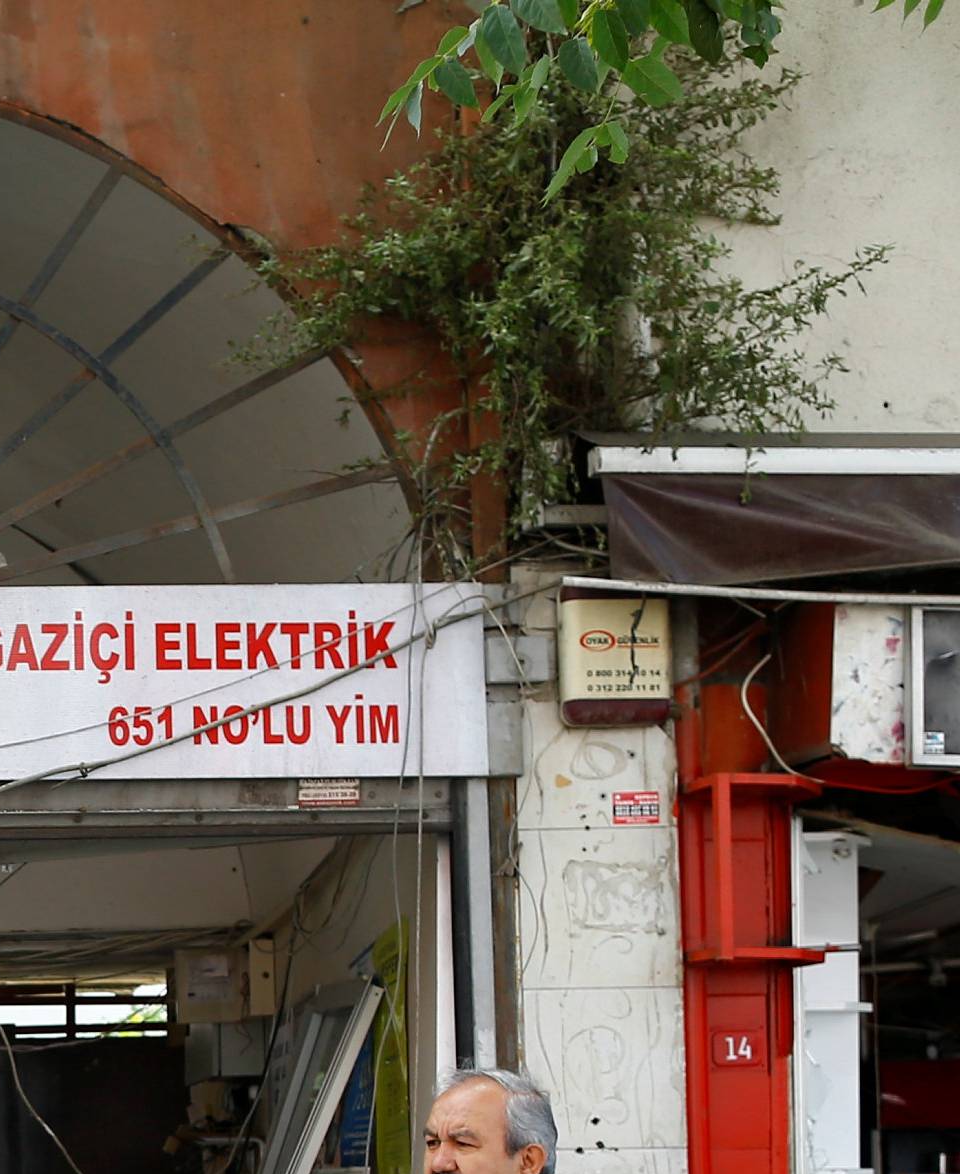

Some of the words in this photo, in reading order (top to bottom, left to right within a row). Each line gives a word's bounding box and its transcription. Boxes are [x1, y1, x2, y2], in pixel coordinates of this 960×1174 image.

[155, 610, 398, 672] ELEKTRİK
[107, 704, 174, 747] 651
[325, 693, 401, 746] YİM
[724, 1035, 753, 1061] 14
